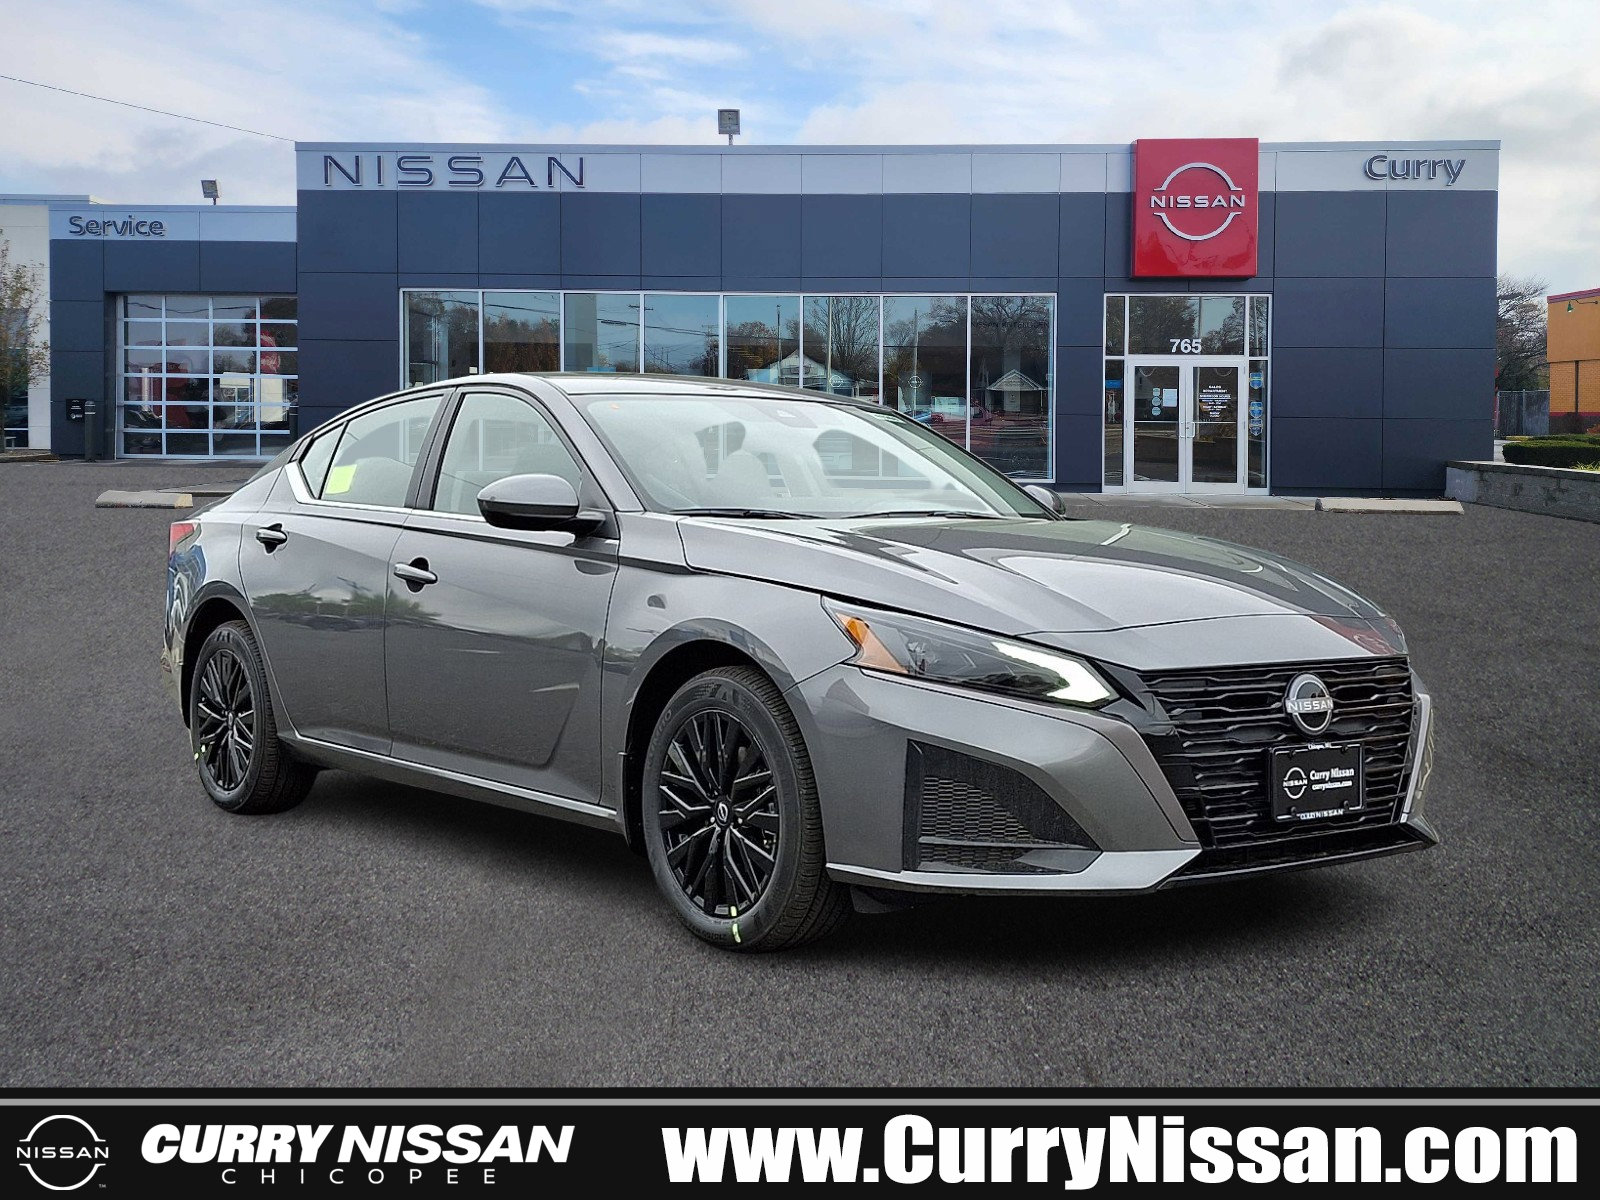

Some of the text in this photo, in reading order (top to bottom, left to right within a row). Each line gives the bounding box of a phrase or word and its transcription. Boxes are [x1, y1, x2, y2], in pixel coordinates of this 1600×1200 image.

[324, 155, 585, 188] NISSAN
[1364, 154, 1466, 187] Curry
[1150, 194, 1245, 208] NISSAN
[69, 214, 165, 236] Service
[1169, 338, 1202, 354] 765
[1286, 699, 1333, 712] NISSAN
[1309, 767, 1355, 781] Curry Nissan
[1282, 779, 1308, 787] NISSAN
